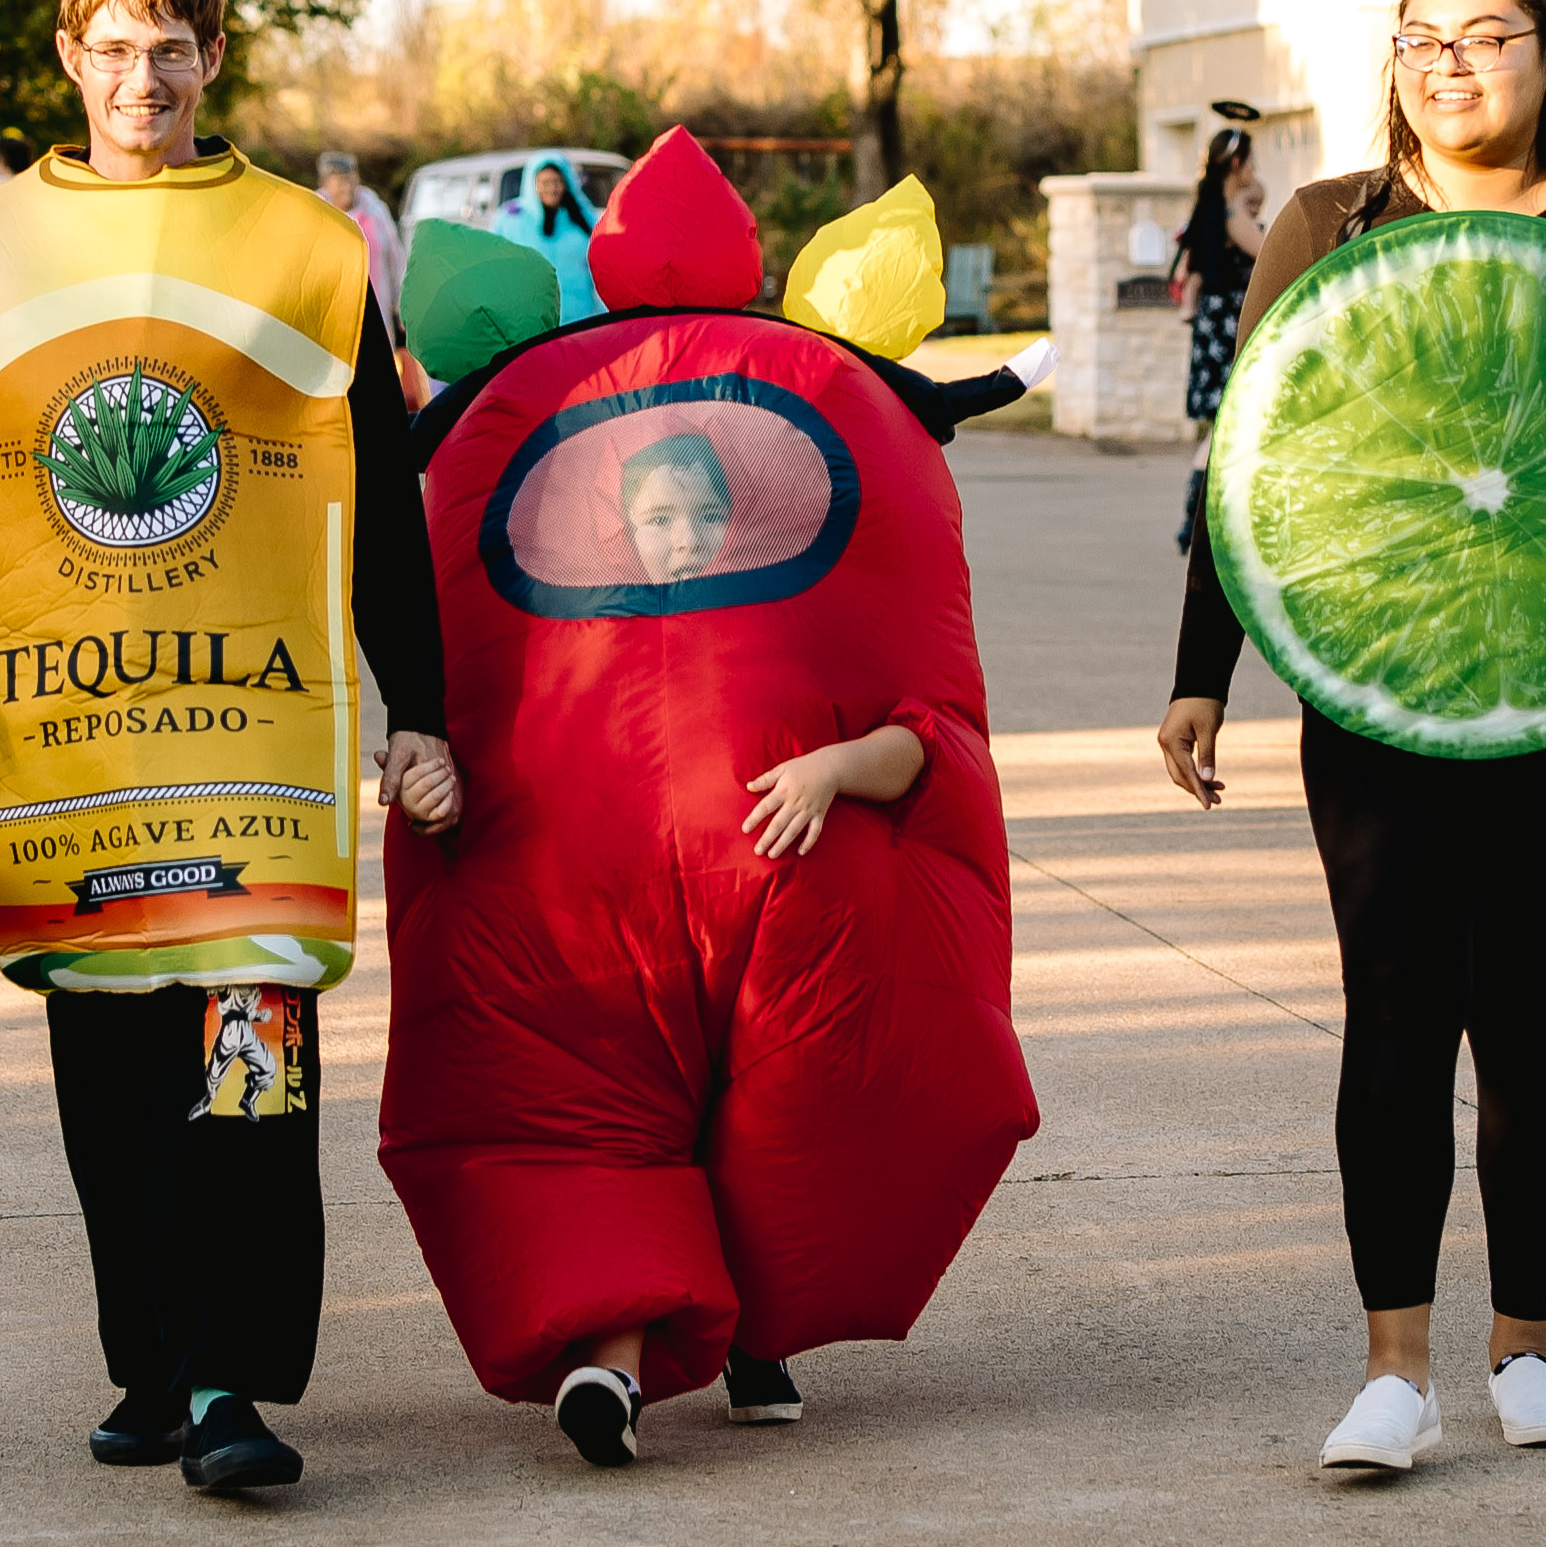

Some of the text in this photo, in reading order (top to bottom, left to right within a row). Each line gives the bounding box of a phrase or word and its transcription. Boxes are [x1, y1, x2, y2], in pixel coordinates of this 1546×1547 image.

[250, 448, 299, 469] 1888
[58, 548, 221, 594] DISTILLERY
[9, 815, 309, 865] 100% AGAVE AZUL
[90, 864, 216, 895] ALWAYS GOOD
